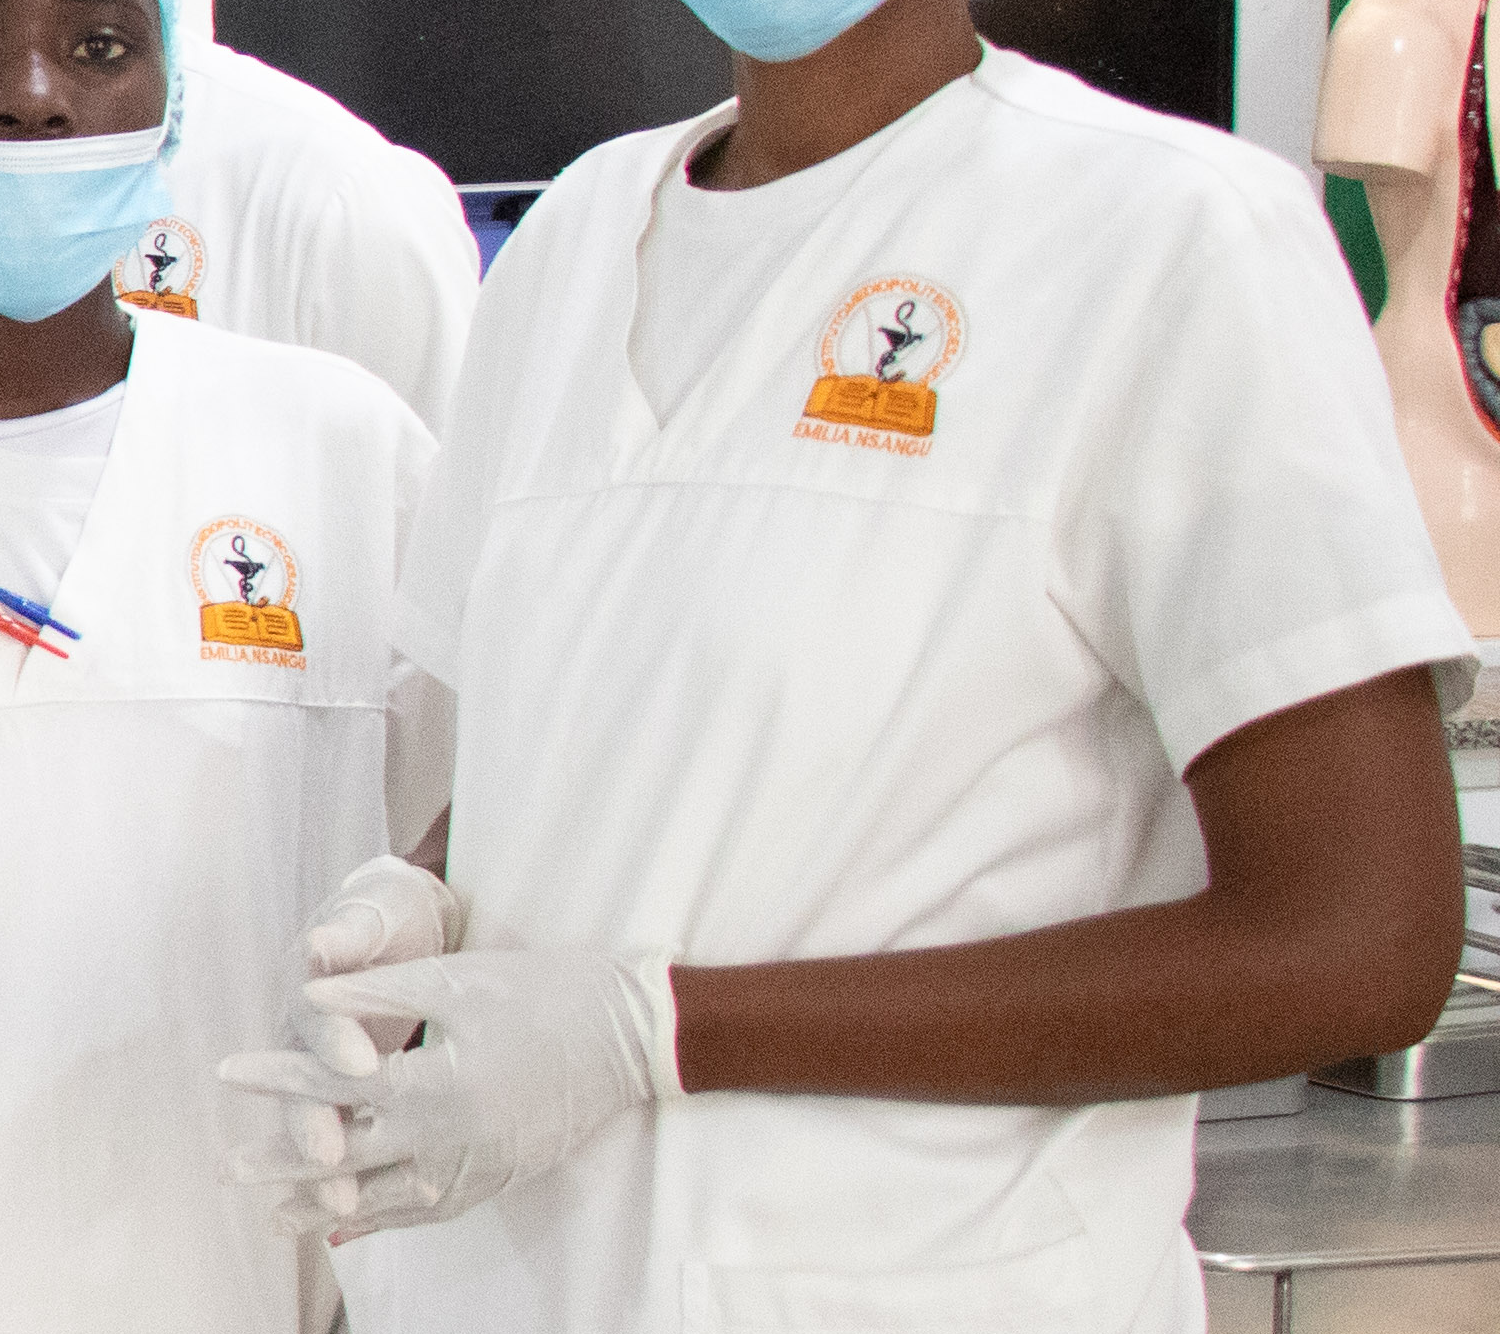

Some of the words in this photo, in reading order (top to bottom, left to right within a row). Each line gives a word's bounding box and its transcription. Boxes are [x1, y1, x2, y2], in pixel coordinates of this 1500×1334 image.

[792, 421, 850, 445] EMILIA
[201, 644, 249, 663] EMILIA
[251, 648, 307, 671] NSANGU
